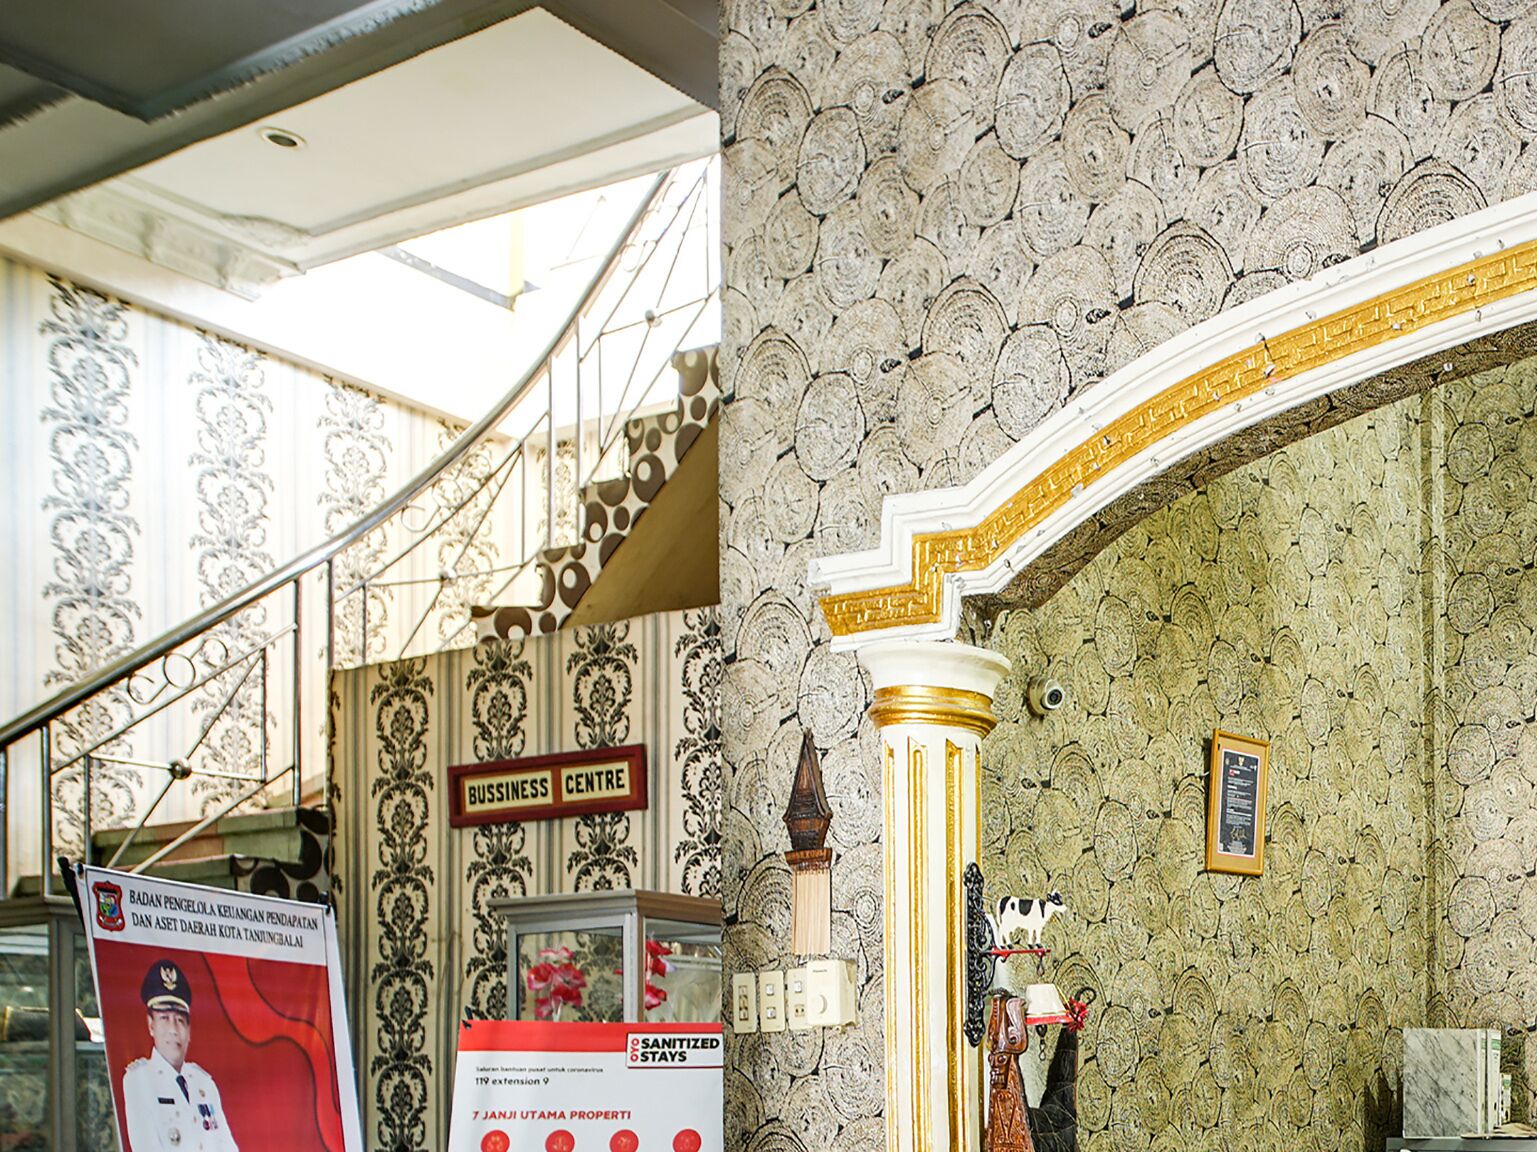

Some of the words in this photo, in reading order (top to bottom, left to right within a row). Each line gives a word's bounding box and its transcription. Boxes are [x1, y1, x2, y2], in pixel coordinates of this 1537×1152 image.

[469, 778, 549, 806] BUSSINESS
[565, 768, 625, 794] CENTRE
[130, 890, 162, 907] BADAN
[164, 895, 215, 917] PENGELOLA
[218, 905, 265, 923] KEUANGAN
[266, 911, 318, 931] PENDAPATAN
[132, 912, 153, 929] DAN
[155, 916, 179, 932] ASET
[181, 921, 217, 937] DAERAH
[219, 925, 242, 941] KOTA
[244, 928, 304, 948] TANJUNGBALAI
[630, 1038, 640, 1063] OYO
[641, 1038, 720, 1050] SANITIZED
[641, 1051, 687, 1063] STAYS
[476, 1077, 489, 1085] 119
[492, 1077, 540, 1085] extension
[543, 1077, 549, 1085] 9
[472, 1111, 479, 1121] 7
[483, 1111, 517, 1121] JANJI
[520, 1111, 568, 1121] UTAMA
[570, 1111, 632, 1120] PROPERTI
